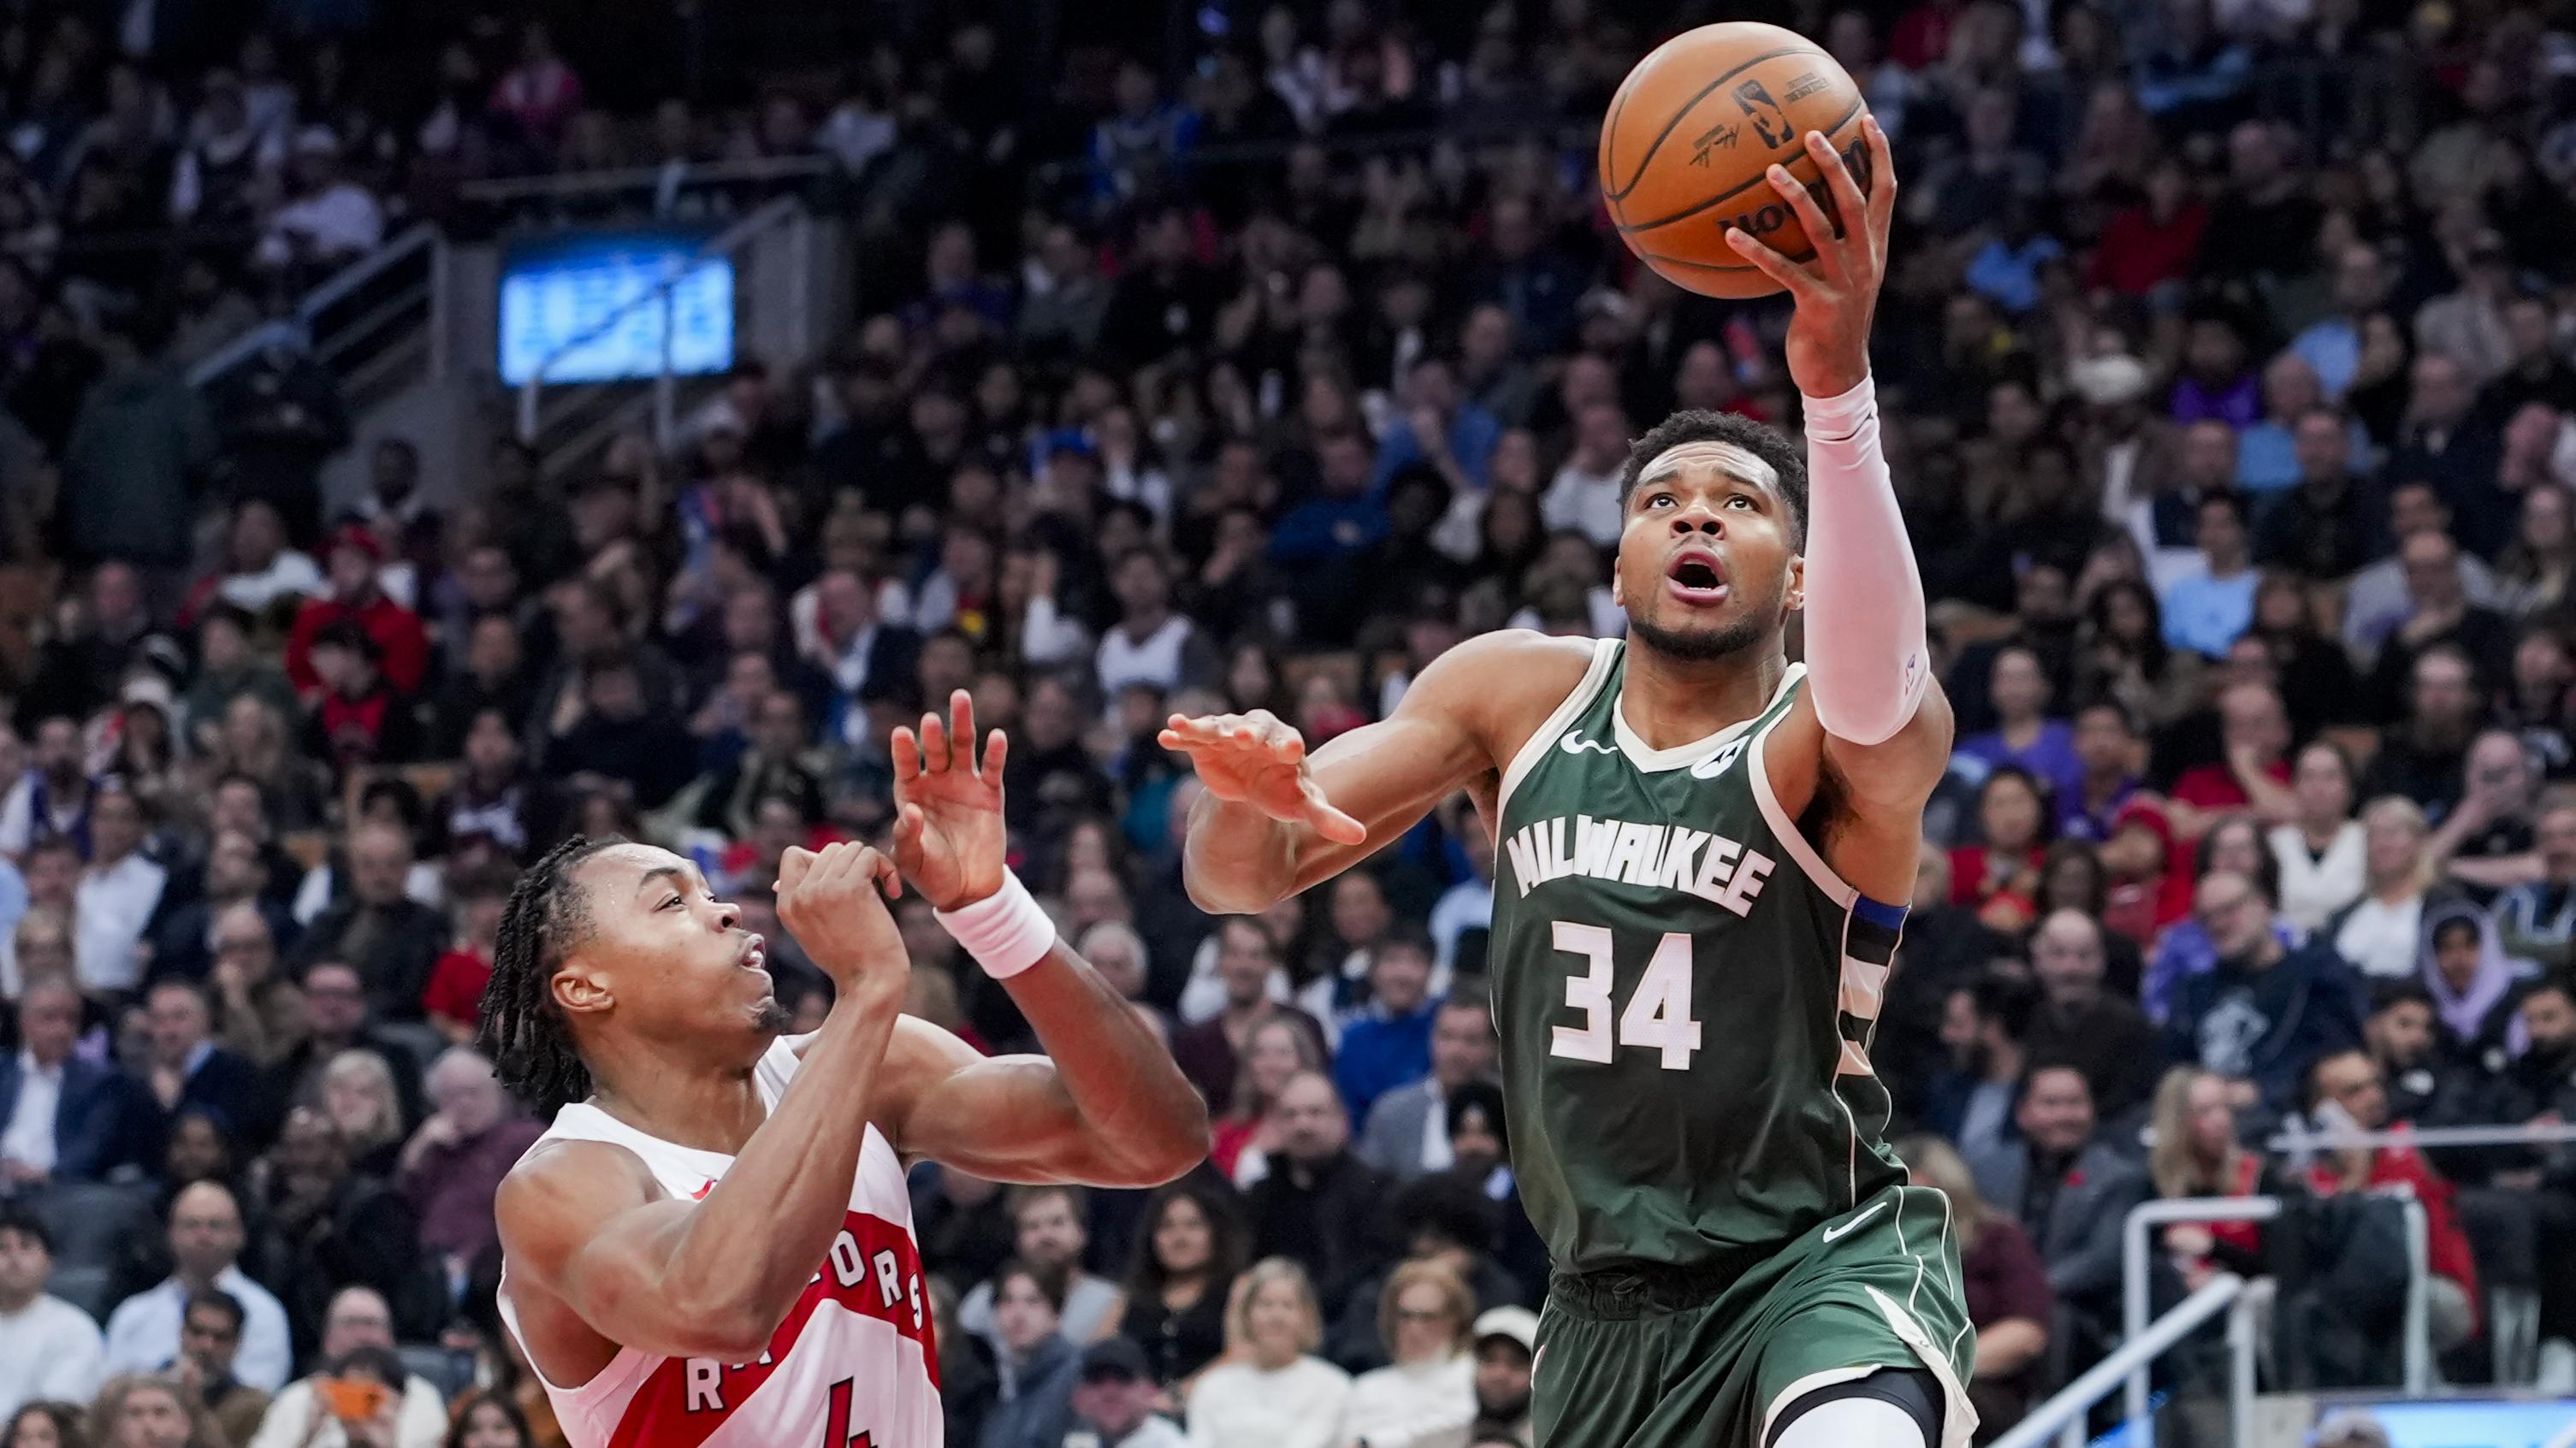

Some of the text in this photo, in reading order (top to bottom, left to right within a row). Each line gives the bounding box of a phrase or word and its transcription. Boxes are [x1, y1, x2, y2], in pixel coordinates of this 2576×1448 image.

[1506, 813, 1777, 919] MILWAUKEE
[1549, 920, 1703, 1071] 34
[685, 1229, 924, 1412] RORS
